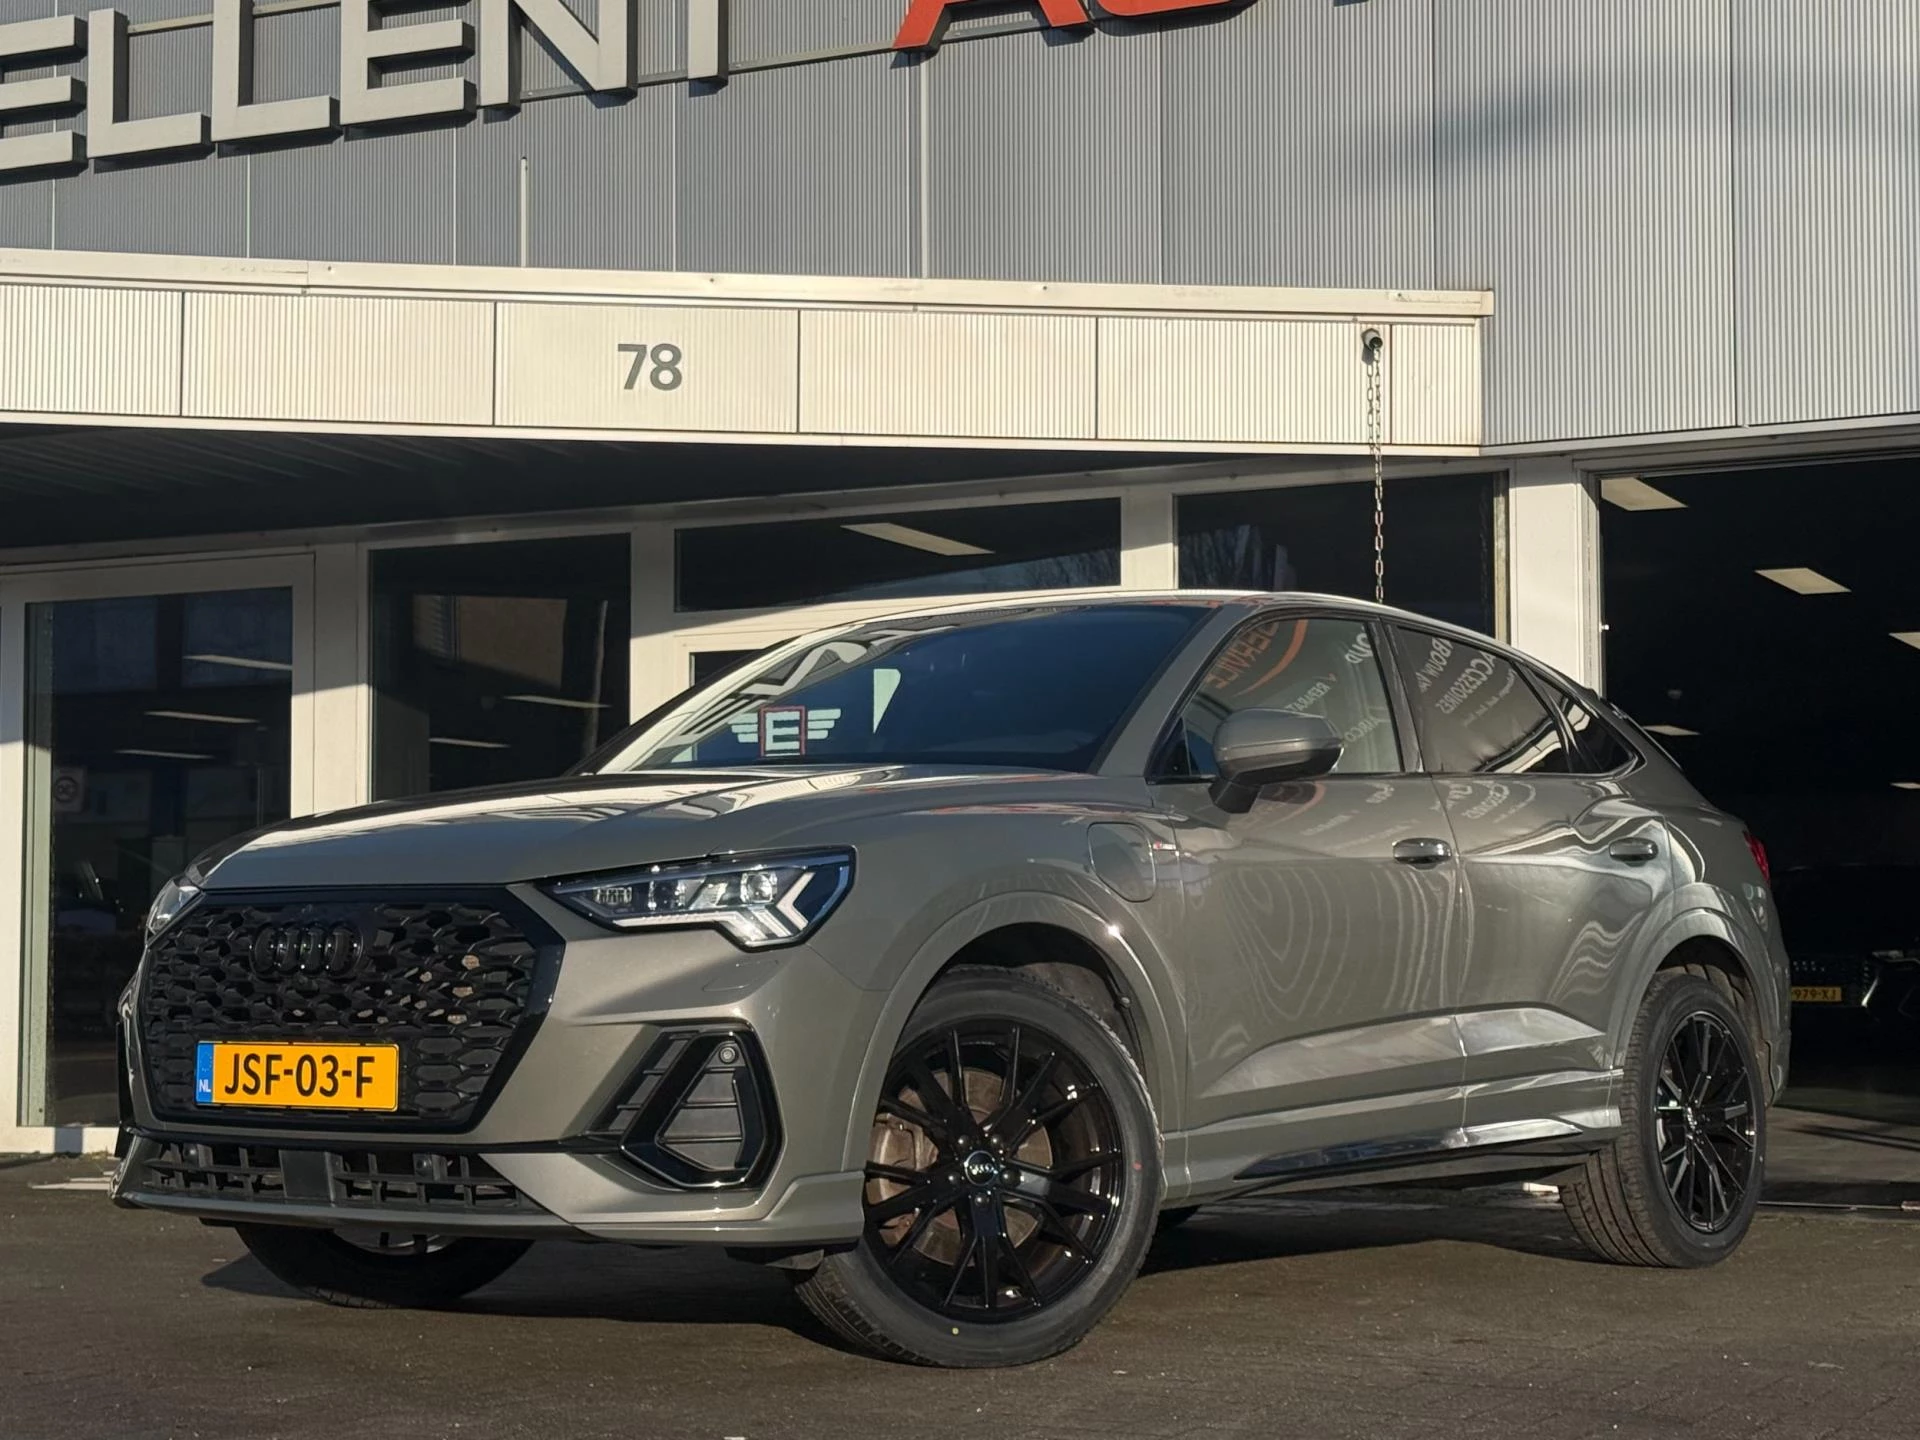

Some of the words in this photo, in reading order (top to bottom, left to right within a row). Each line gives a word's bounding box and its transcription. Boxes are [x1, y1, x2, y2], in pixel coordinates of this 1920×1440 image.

[617, 344, 683, 391] 78
[199, 1079, 212, 1093] NL
[224, 1052, 376, 1099] JSF-03-F
